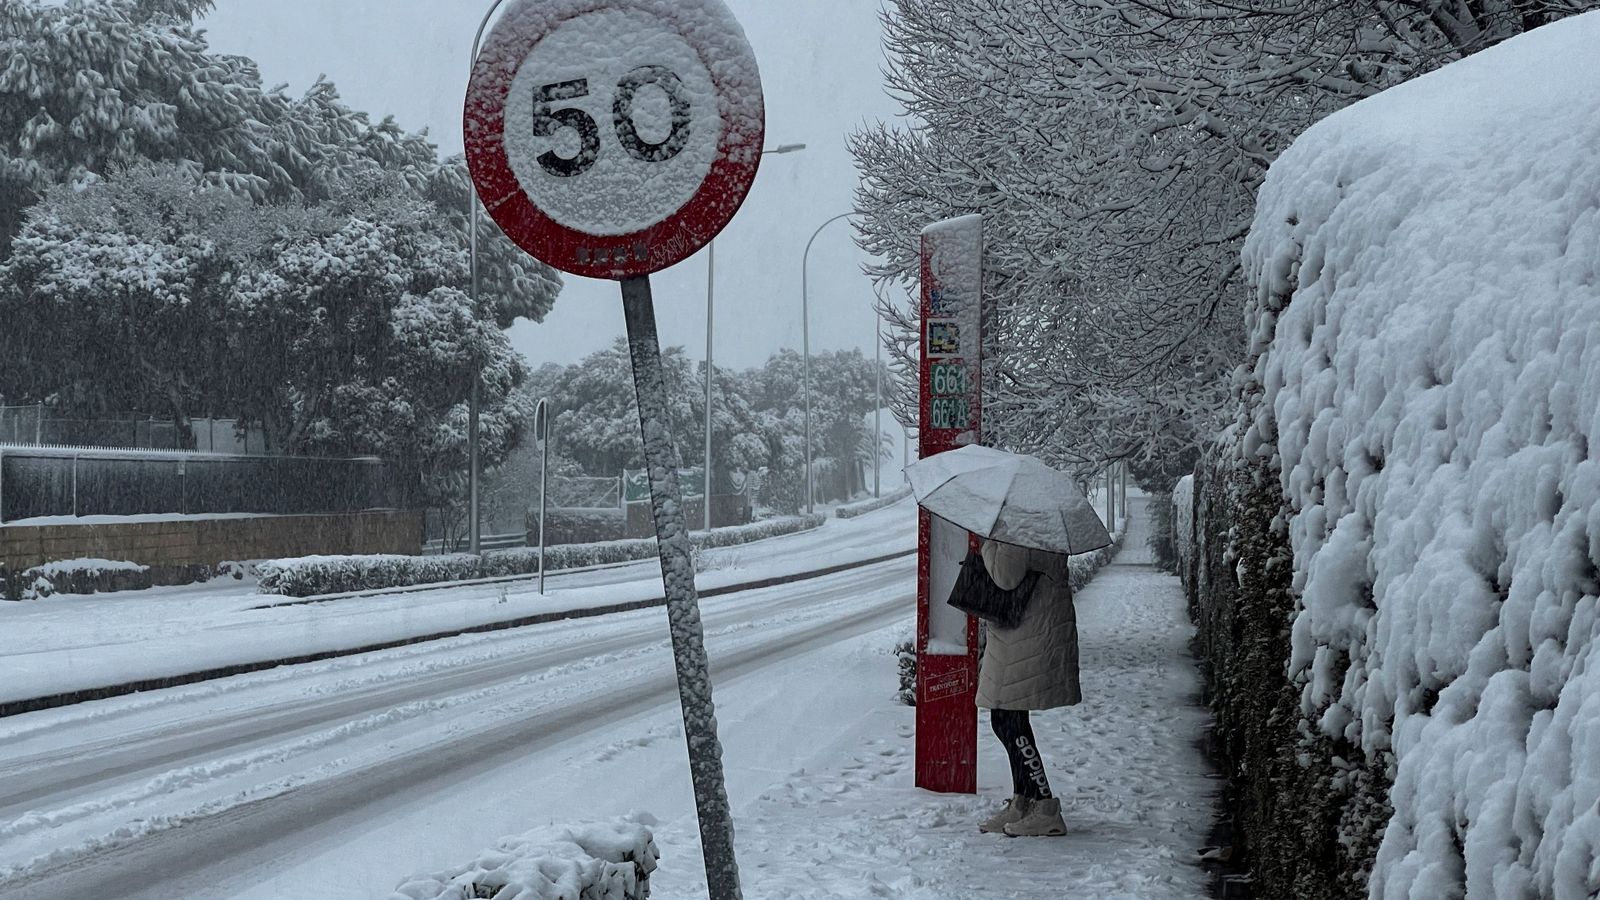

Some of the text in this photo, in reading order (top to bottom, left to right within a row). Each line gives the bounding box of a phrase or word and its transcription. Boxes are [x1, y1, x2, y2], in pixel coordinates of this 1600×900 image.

[533, 66, 691, 177] 50
[935, 365, 967, 394] 661
[1015, 735, 1051, 796] adidas
